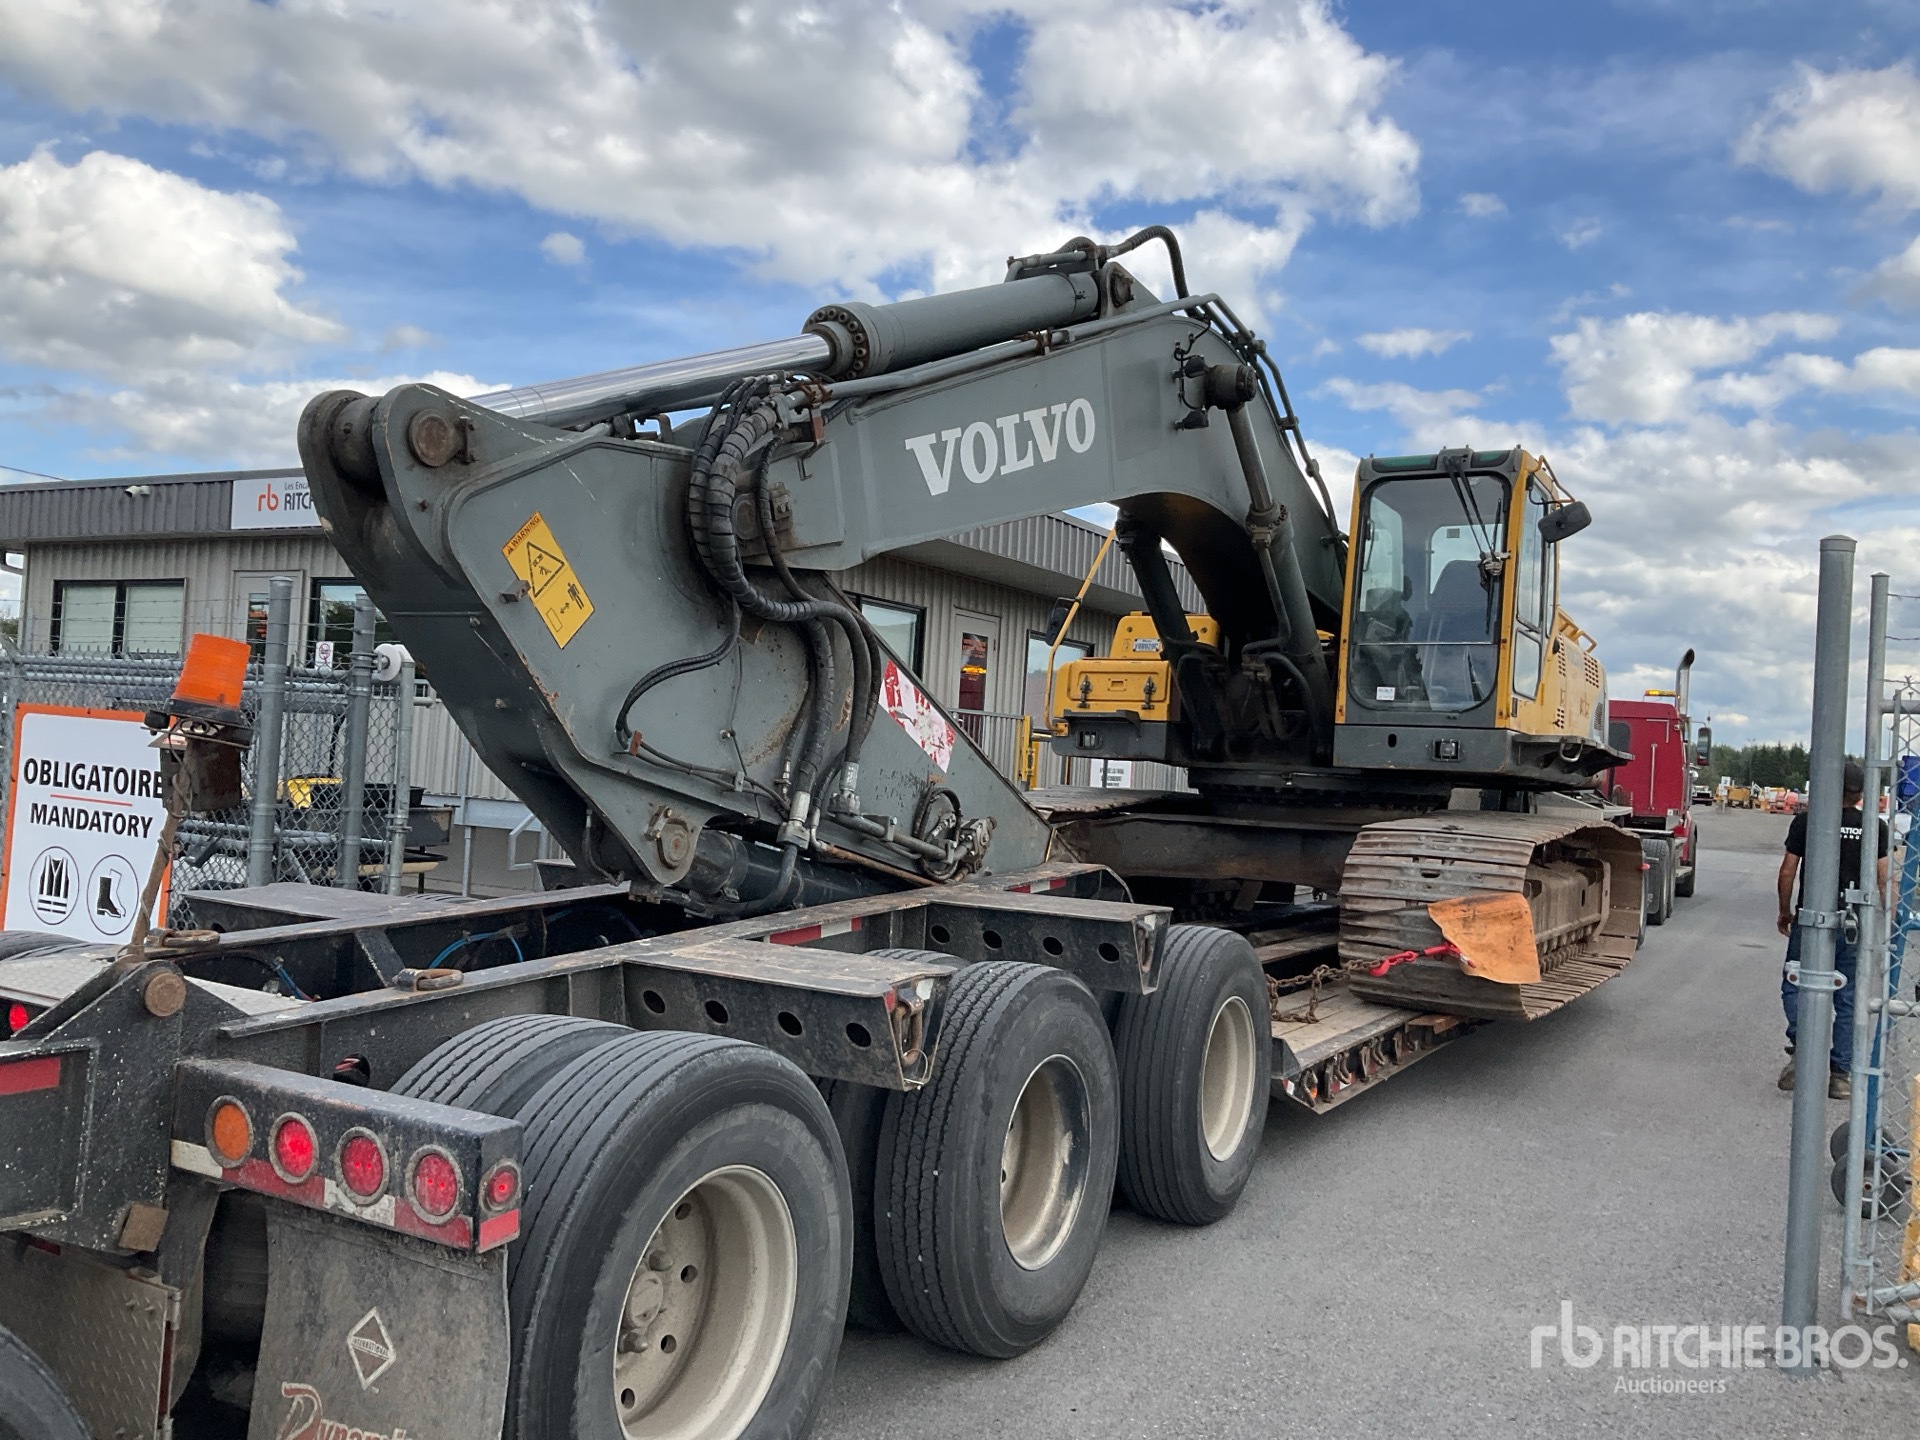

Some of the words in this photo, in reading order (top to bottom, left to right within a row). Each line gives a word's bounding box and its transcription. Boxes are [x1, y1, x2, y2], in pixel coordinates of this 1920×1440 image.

[904, 398, 1096, 496] VOLVO
[284, 482, 294, 490] Les
[510, 515, 541, 547] WARNING
[23, 757, 163, 799] OBLIGATOIRE
[30, 802, 153, 839] MANDATORY
